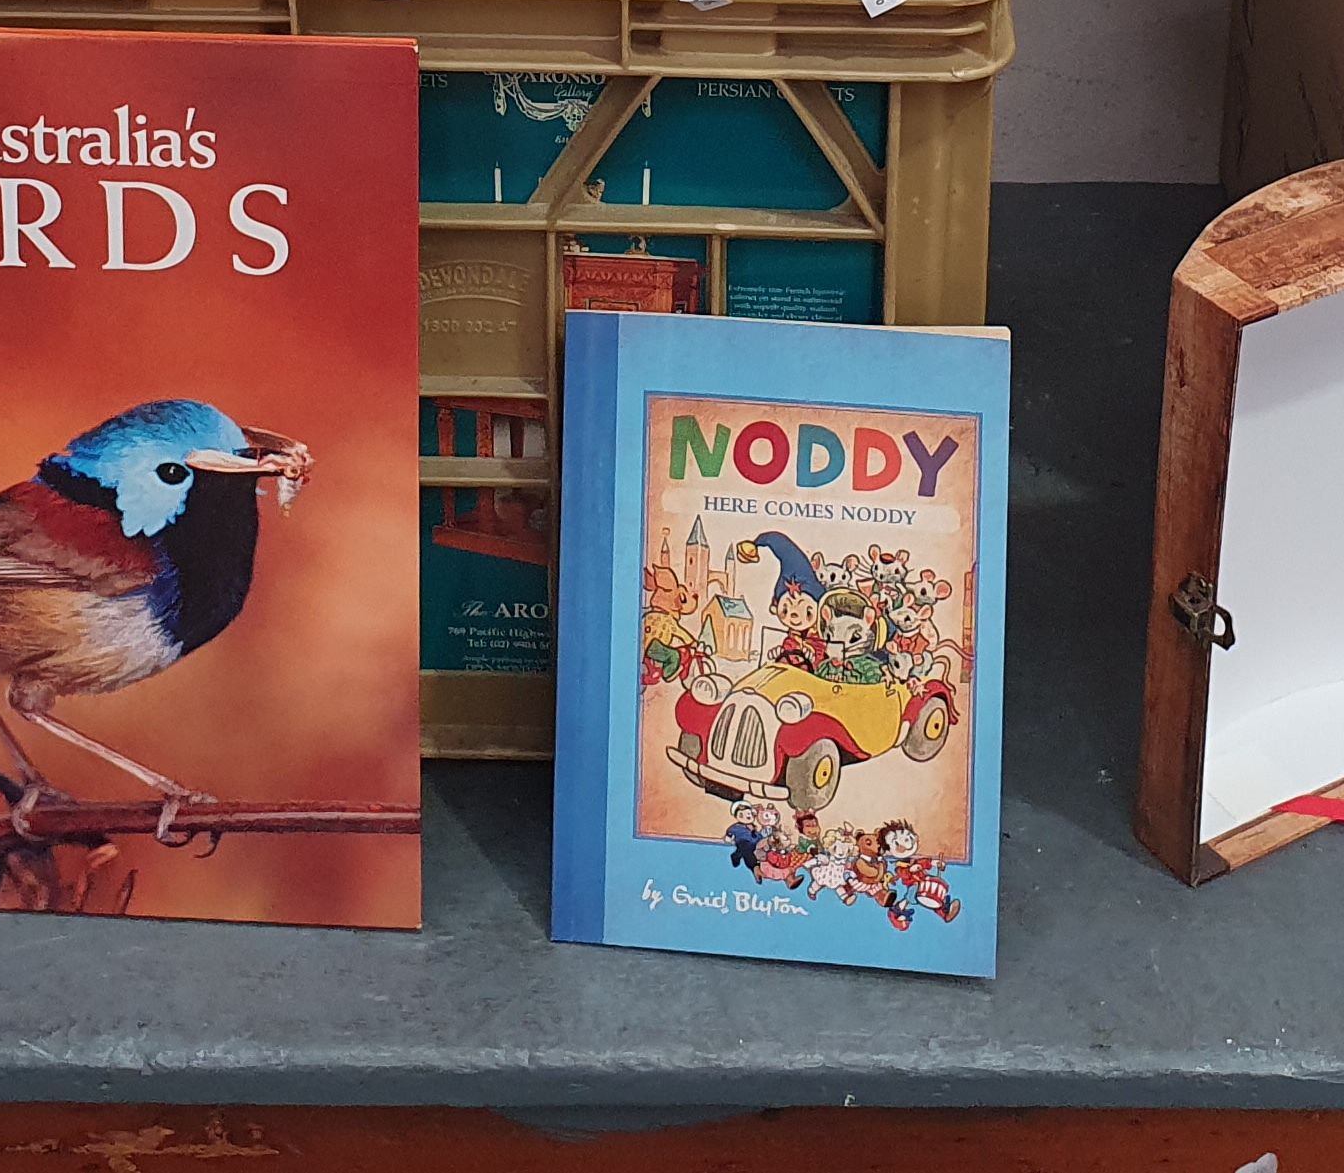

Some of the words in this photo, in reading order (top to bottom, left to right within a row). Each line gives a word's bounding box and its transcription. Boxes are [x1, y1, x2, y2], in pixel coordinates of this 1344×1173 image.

[697, 82, 772, 99] PERSIAN
[669, 414, 959, 497] NODDY
[703, 494, 758, 515] HERE
[764, 499, 834, 520] COMES
[841, 505, 917, 526] NODDY
[640, 878, 665, 910] by
[671, 884, 729, 915] Enid
[735, 890, 809, 918] Blyton
